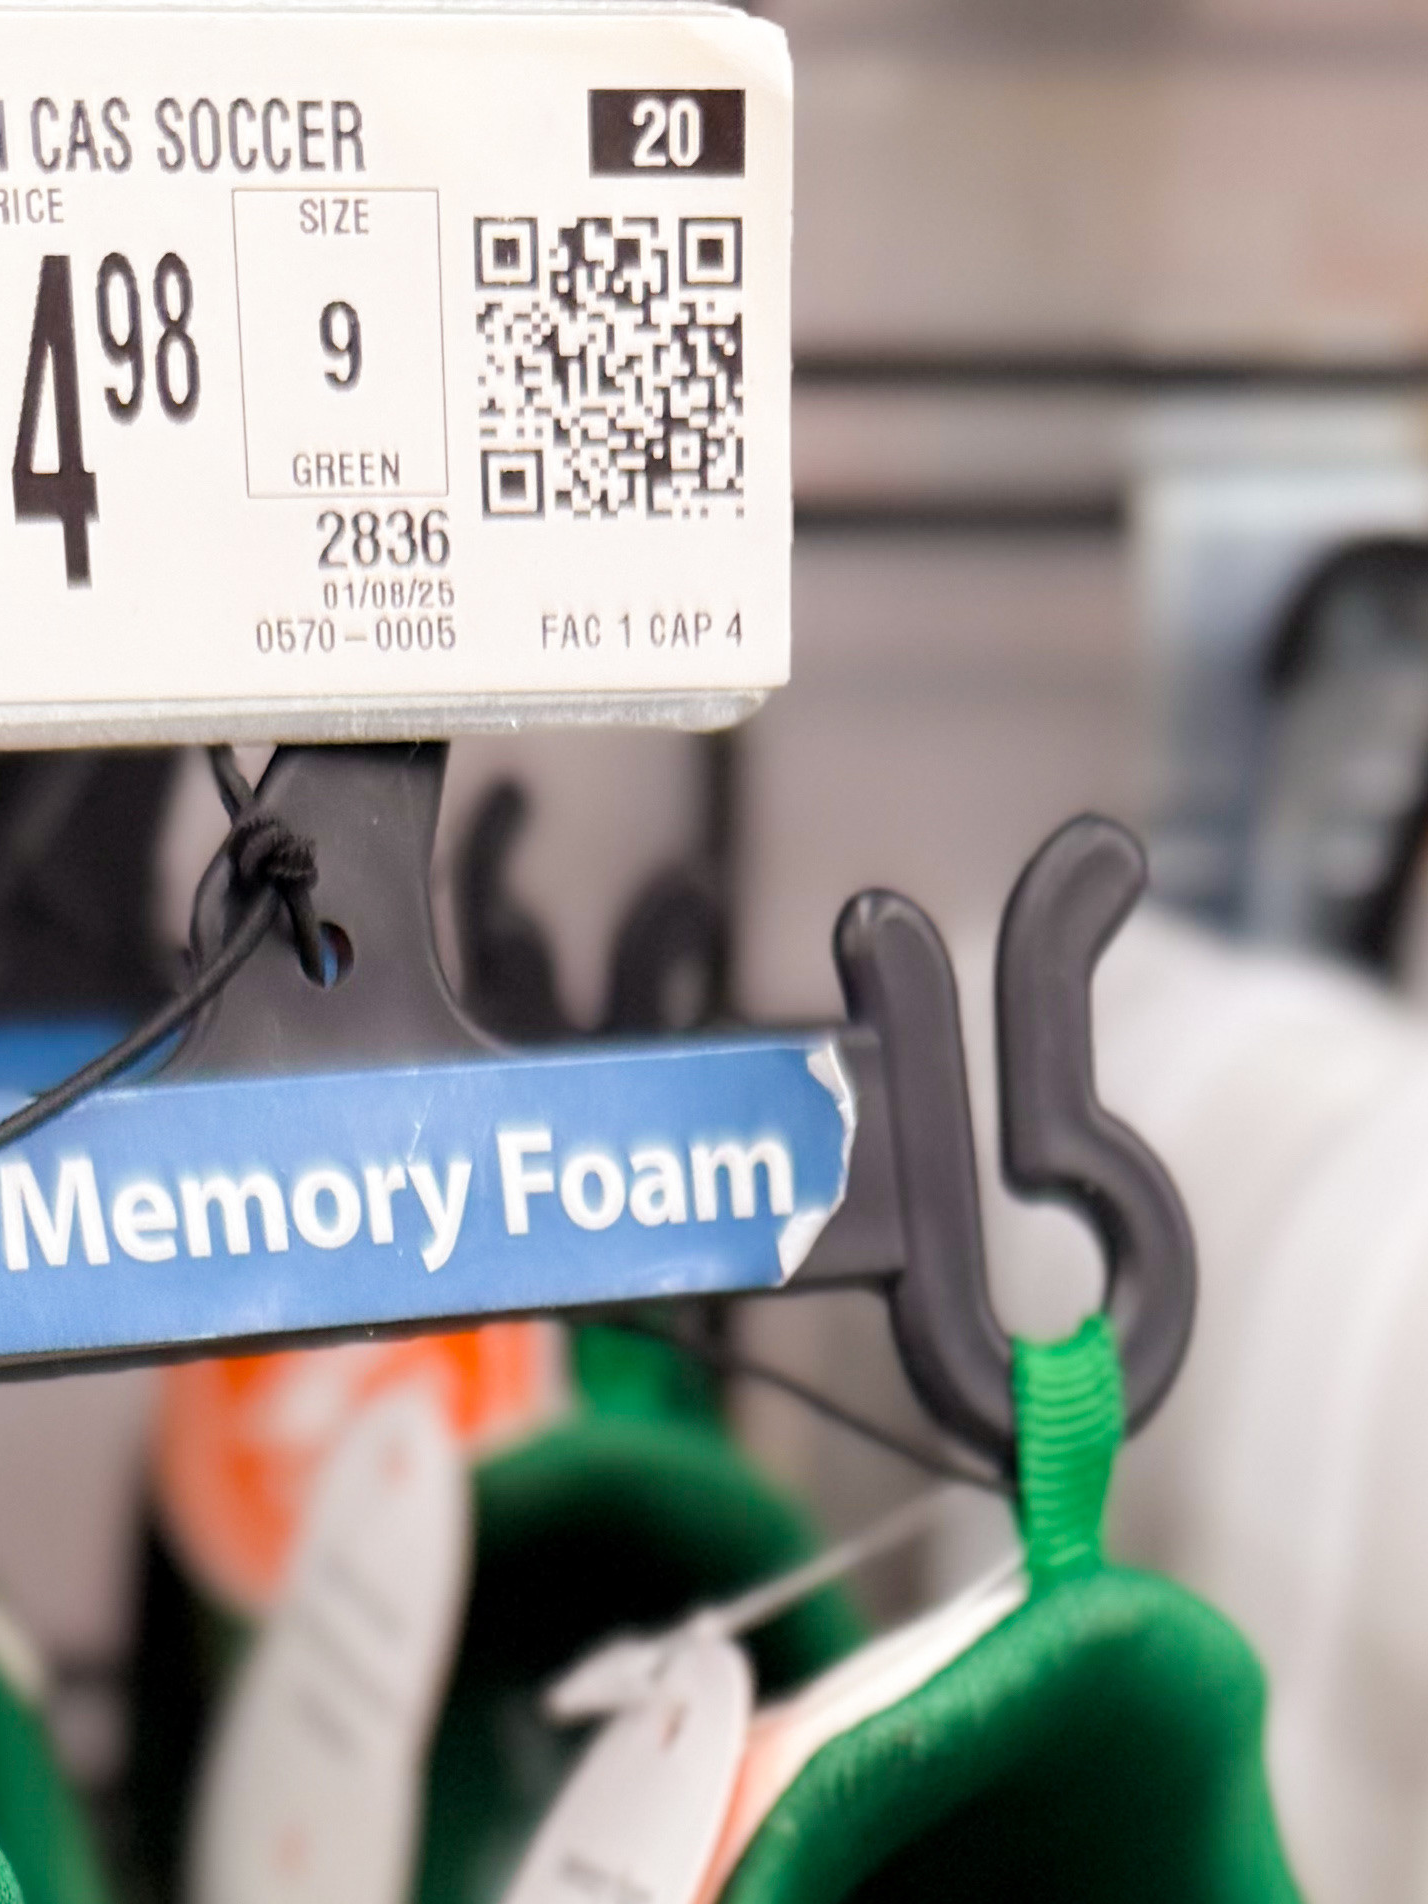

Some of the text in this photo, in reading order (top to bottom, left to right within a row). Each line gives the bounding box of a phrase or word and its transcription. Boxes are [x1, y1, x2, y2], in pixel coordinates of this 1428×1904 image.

[30, 96, 133, 174] CAS
[154, 96, 366, 174] SOCCER
[630, 96, 703, 169] 20
[298, 198, 372, 236] SIZE
[318, 299, 364, 394] 9
[292, 450, 402, 489] GREEN
[316, 508, 452, 570] 2836
[323, 579, 457, 611] 01/08/25
[541, 610, 745, 651] FAC 1 CAP 4
[494, 1125, 796, 1239] Foam
